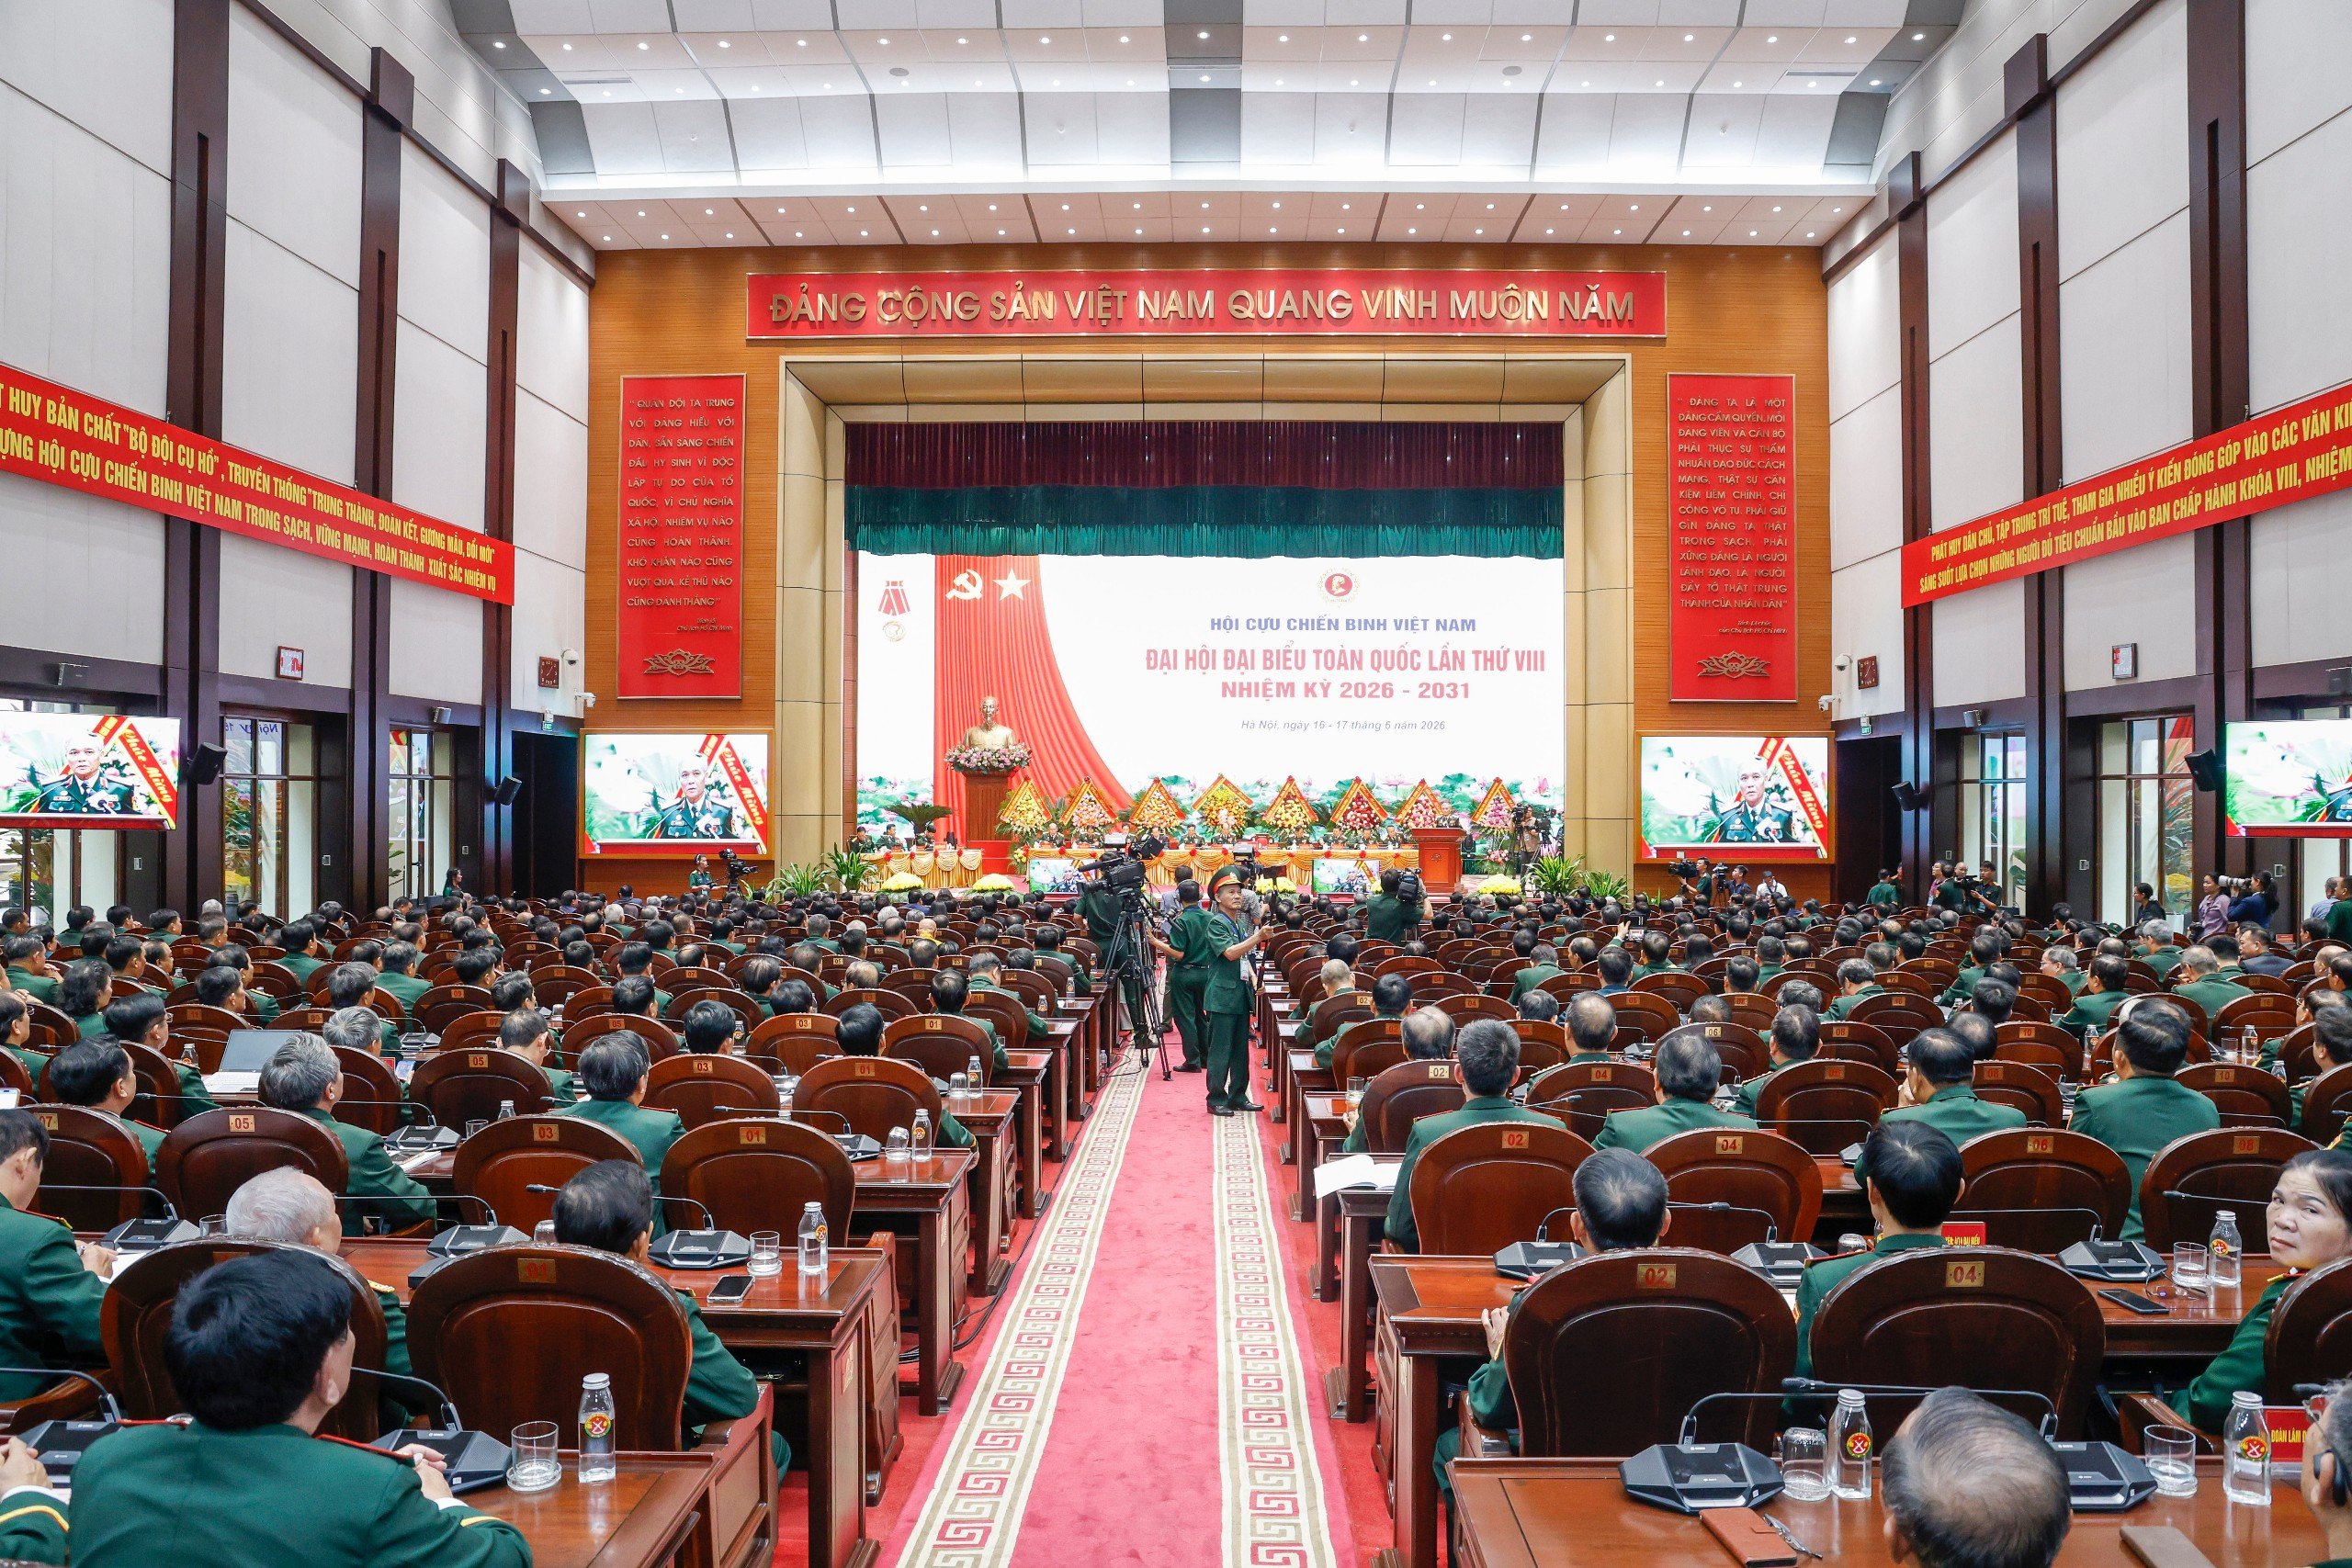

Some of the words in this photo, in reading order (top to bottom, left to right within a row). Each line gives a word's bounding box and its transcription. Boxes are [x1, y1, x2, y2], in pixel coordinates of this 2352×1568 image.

[770, 283, 866, 322] ĐẢNG
[877, 286, 980, 328] CỘNG
[990, 281, 1056, 321] SẢN
[1064, 284, 1128, 326] VIỆT
[1137, 289, 1215, 320] NAM
[1227, 289, 1353, 320] QUANG
[1361, 289, 1437, 320] VINH
[1450, 283, 1548, 321] MUÔN
[1559, 284, 1634, 321] NĂM
[670, 398, 684, 409] ĐỘI
[706, 399, 734, 407] TRUNG
[1690, 396, 1718, 406] ĐẢNG
[1709, 445, 1732, 454] THỰC
[698, 457, 706, 466] VÌ
[713, 457, 734, 467] ĐỘC
[9, 387, 41, 420] HUY
[47, 396, 79, 432] BẢN
[84, 412, 120, 446] CHẤT
[152, 434, 173, 466] ĐỘI
[177, 444, 194, 473] CỤ
[228, 461, 270, 494] TRUYỀN
[273, 476, 307, 506] THỐNG
[345, 502, 376, 530] THÀNH,
[379, 513, 401, 536] ĐOÀN
[403, 518, 418, 544] KẾT,
[421, 527, 446, 549] GƯƠNG
[447, 532, 464, 558] MẪU,
[467, 537, 478, 559] ĐỔI
[1931, 536, 1947, 562] PHÁT
[1949, 537, 1962, 557] HUY
[1963, 531, 1977, 554] DÂN
[1979, 522, 1995, 547] CHỦ,
[1996, 519, 2009, 544] TẬP
[2012, 513, 2036, 536] TRUNG
[2038, 503, 2050, 526] TRÍ
[2052, 497, 2070, 524] TUỆ,
[2072, 491, 2096, 516] THAM
[2099, 485, 2114, 508] GIA
[2117, 469, 2145, 502] NHIỀU
[2148, 467, 2154, 492] Ý
[2157, 457, 2181, 490] KIẾN
[2184, 450, 2214, 480] ĐÓNG
[2217, 439, 2241, 469] GÓP
[2244, 430, 2267, 460] VÀO
[2272, 419, 2298, 452] CÁC
[2301, 409, 2330, 442] VĂN
[39, 438, 64, 473] HỘI
[70, 450, 100, 481] CỰU
[105, 460, 147, 493] CHIẾN
[152, 473, 182, 503] BINH
[186, 484, 211, 514] VIỆT
[215, 494, 242, 521] NAM
[245, 503, 280, 532] TRONG
[283, 514, 312, 544] SẠCH,
[316, 523, 340, 549] VỮNG
[344, 533, 372, 559] MẠNH,
[375, 542, 397, 565] HOÀN
[400, 549, 424, 572] THÀNH
[428, 556, 447, 579] XUẤT
[448, 560, 462, 582] SẮC
[465, 569, 485, 591] NHIỆM
[488, 576, 496, 594] VỤ
[1920, 573, 1937, 593] SÁNG
[1938, 564, 1954, 587] SUỐT
[1956, 564, 1968, 585] LỰA
[1970, 557, 1988, 580] CHỌN
[1990, 550, 2014, 573] NHỮNG
[2017, 538, 2040, 566] NGƯỜI
[2041, 532, 2052, 558] ĐỦ
[2054, 530, 2073, 554] TIÊU
[2075, 516, 2104, 548] CHUẨN
[2107, 511, 2125, 540] BẦU
[2128, 508, 2146, 534] VÀO
[2149, 502, 2170, 528] BAN
[2173, 487, 2201, 521] CHẤP
[2205, 481, 2236, 513] HÀNH
[2240, 468, 2273, 502] KHÓA
[2277, 463, 2301, 491] VIII,
[2306, 446, 2352, 482] NHIỆM
[1679, 537, 1715, 546] TRONG
[1679, 551, 1706, 560] XỨNG
[1211, 615, 1239, 633] HỘI
[1246, 617, 1281, 633] CỰU
[1287, 615, 1339, 631] CHIẾN
[1345, 619, 1387, 631] BINH
[1394, 616, 1430, 634] VIỆT
[1435, 619, 1476, 631] NAM
[1146, 649, 1178, 674] ĐẠI
[1185, 645, 1216, 674] HỘI
[1224, 649, 1255, 674] ĐẠI
[1262, 640, 1306, 671] BIỂU
[1313, 645, 1363, 671] TOÀN
[1371, 642, 1421, 672] QUỐC
[1429, 642, 1465, 671] LẦN
[1472, 646, 1510, 671] THỨ
[1514, 650, 1545, 671] VIII
[1222, 678, 1295, 702] NHIỆM
[1304, 679, 1331, 697] KỲ
[1340, 682, 1394, 699] 2026
[1419, 682, 1469, 699] 2031
[1241, 720, 1254, 729] Hà
[1259, 720, 1279, 730] Nội,
[1283, 721, 1309, 731] ngày
[1313, 721, 1325, 729] 16
[1336, 721, 1348, 729] 17
[1351, 721, 1382, 731] tháng
[1385, 721, 1391, 729] 6
[1395, 721, 1418, 729] năm
[1421, 721, 1445, 729] 2026
[473, 1056, 484, 1066] 05
[697, 1063, 708, 1071] 03
[860, 1066, 870, 1075] 01
[1433, 1067, 1444, 1077] 02
[1596, 1069, 1608, 1079] 04
[2220, 1072, 2230, 1080] 10
[235, 1118, 249, 1129] 05
[538, 1127, 554, 1139] 03
[746, 1129, 760, 1142] 01
[1508, 1134, 1522, 1145] 02
[1721, 1139, 1737, 1151] 04
[2032, 1138, 2048, 1150] 06
[526, 1262, 548, 1279] 01
[1952, 1265, 1976, 1283] 04
[1645, 1269, 1667, 1285] 02
[2271, 1427, 2287, 1442] ĐOÀN
[2289, 1427, 2301, 1442] LÂM
